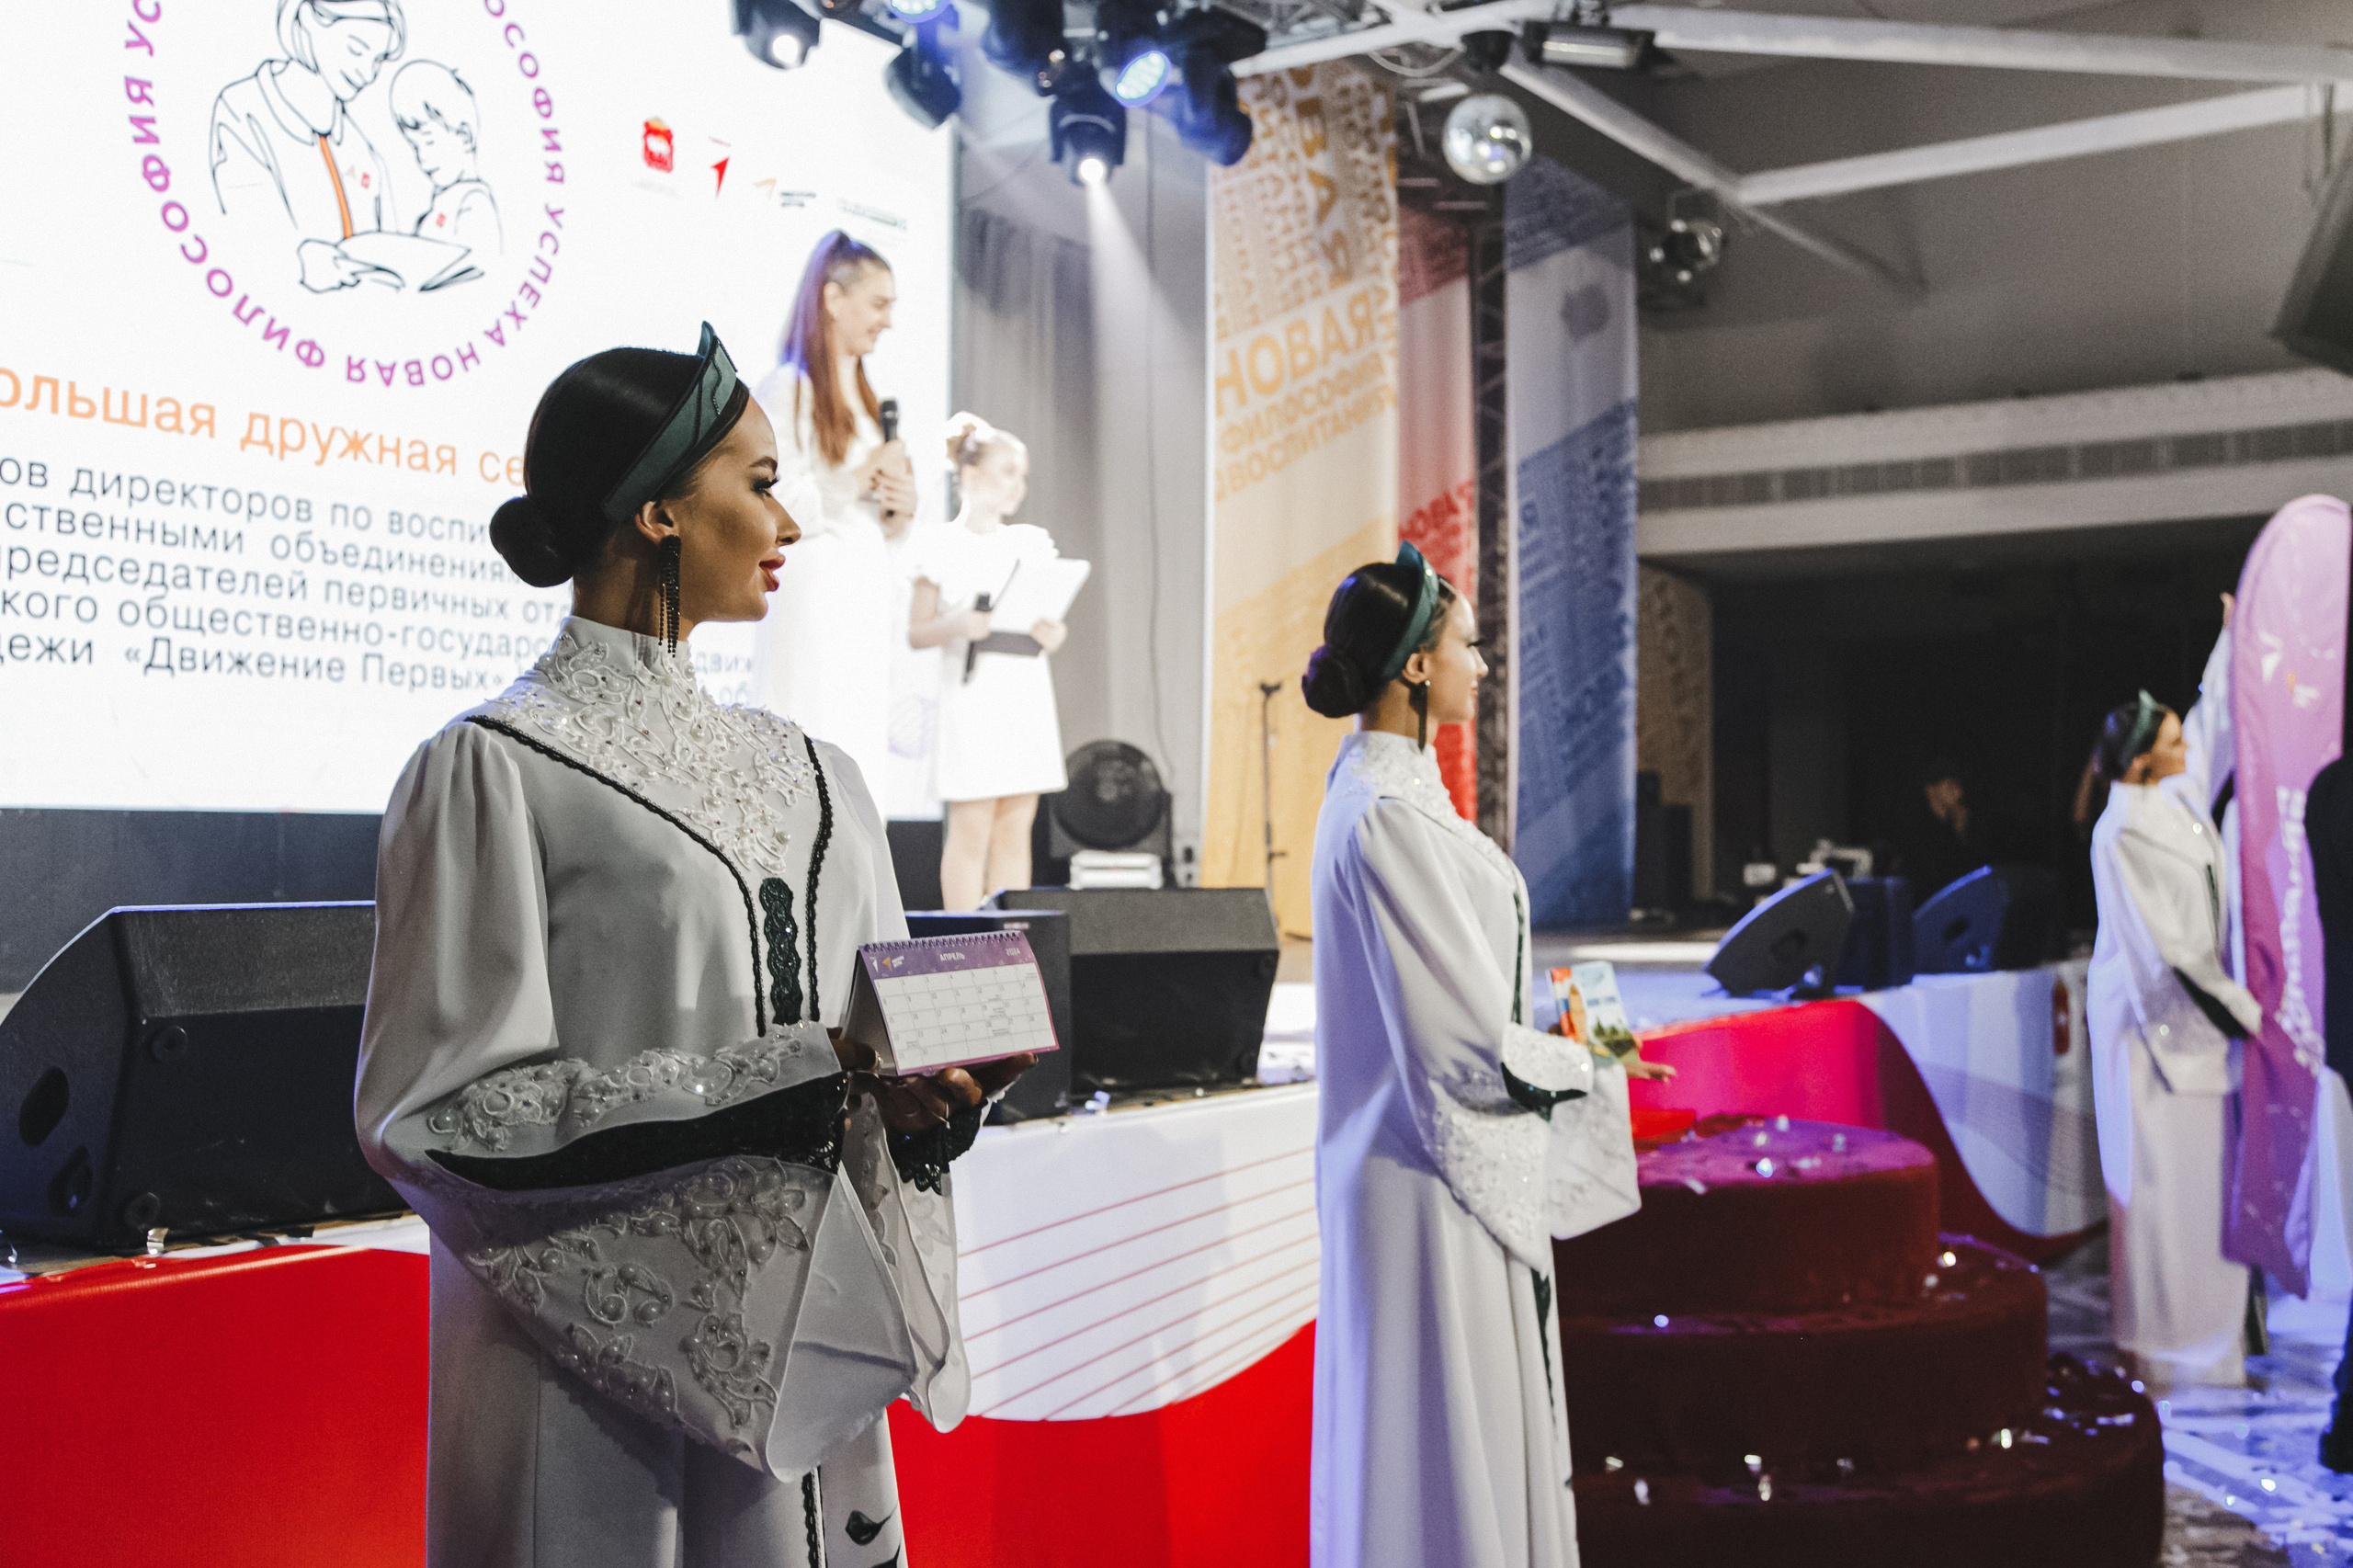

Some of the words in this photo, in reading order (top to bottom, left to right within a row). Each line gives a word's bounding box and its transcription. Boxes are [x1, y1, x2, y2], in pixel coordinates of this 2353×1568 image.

[124, 75, 326, 369] ФИЛОСОФИЯ
[483, 204, 565, 348] УСПЕХА
[346, 342, 482, 387] НОВАЯ
[1215, 290, 1376, 418] НОВАЯ
[0, 367, 216, 439] ольшая
[239, 412, 457, 476] дружная
[0, 457, 49, 489] ов
[69, 467, 313, 524] директоров
[330, 503, 373, 531] по
[5, 502, 244, 553] ственными
[1, 589, 97, 623] кого
[324, 579, 508, 619] первичных
[0, 633, 93, 665] ежи
[124, 636, 346, 684] «Движение
[361, 652, 504, 693] Первых»
[939, 952, 965, 962] АПРЕЛЬ
